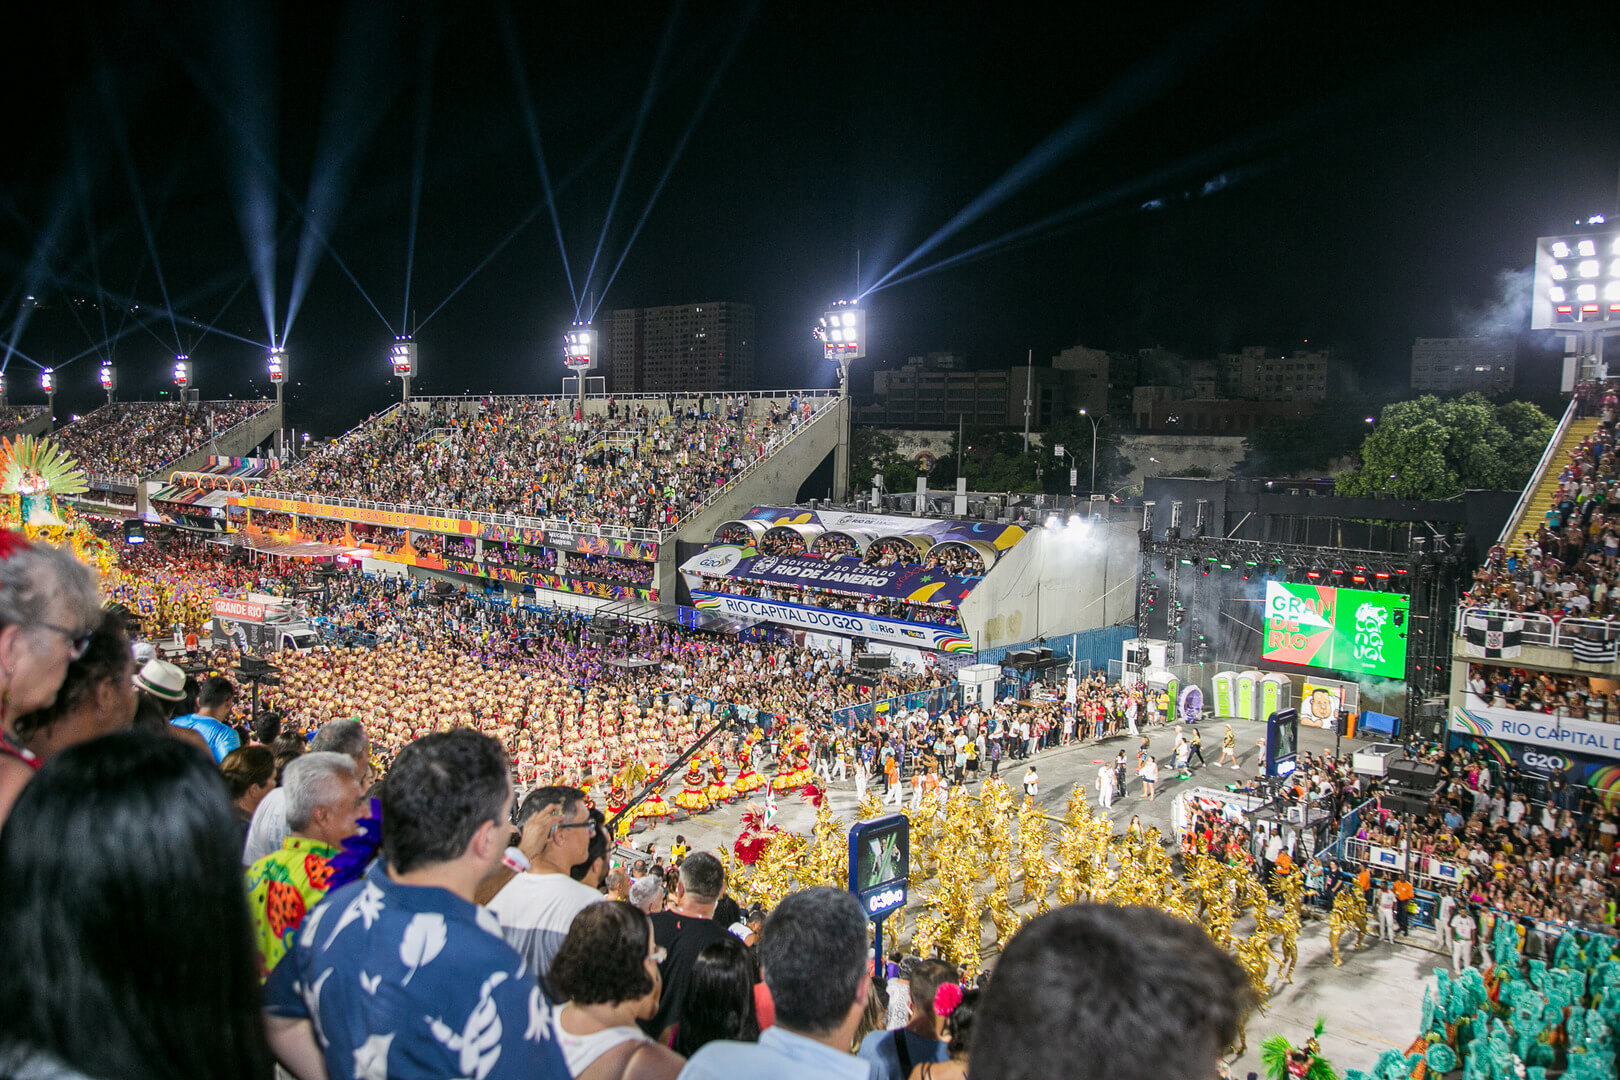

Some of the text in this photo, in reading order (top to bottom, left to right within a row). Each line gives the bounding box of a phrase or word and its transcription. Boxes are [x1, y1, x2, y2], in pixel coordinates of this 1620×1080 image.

[308, 502, 324, 514] QUE
[353, 511, 416, 525] ACONTECEM
[427, 518, 455, 529] AQUI
[771, 564, 889, 587] RIO DE JANEIRO
[782, 559, 896, 577] GOVERNO DO ESTADO
[215, 600, 262, 618] GRANDE RIO
[726, 599, 863, 631] RIO CAPITAL DO G20
[878, 624, 895, 634] Rio
[1270, 613, 1299, 632] DE
[1269, 631, 1308, 650] RIO
[1501, 720, 1531, 736] RIO
[1535, 726, 1608, 748] CAPITAL
[1523, 752, 1564, 770] G20
